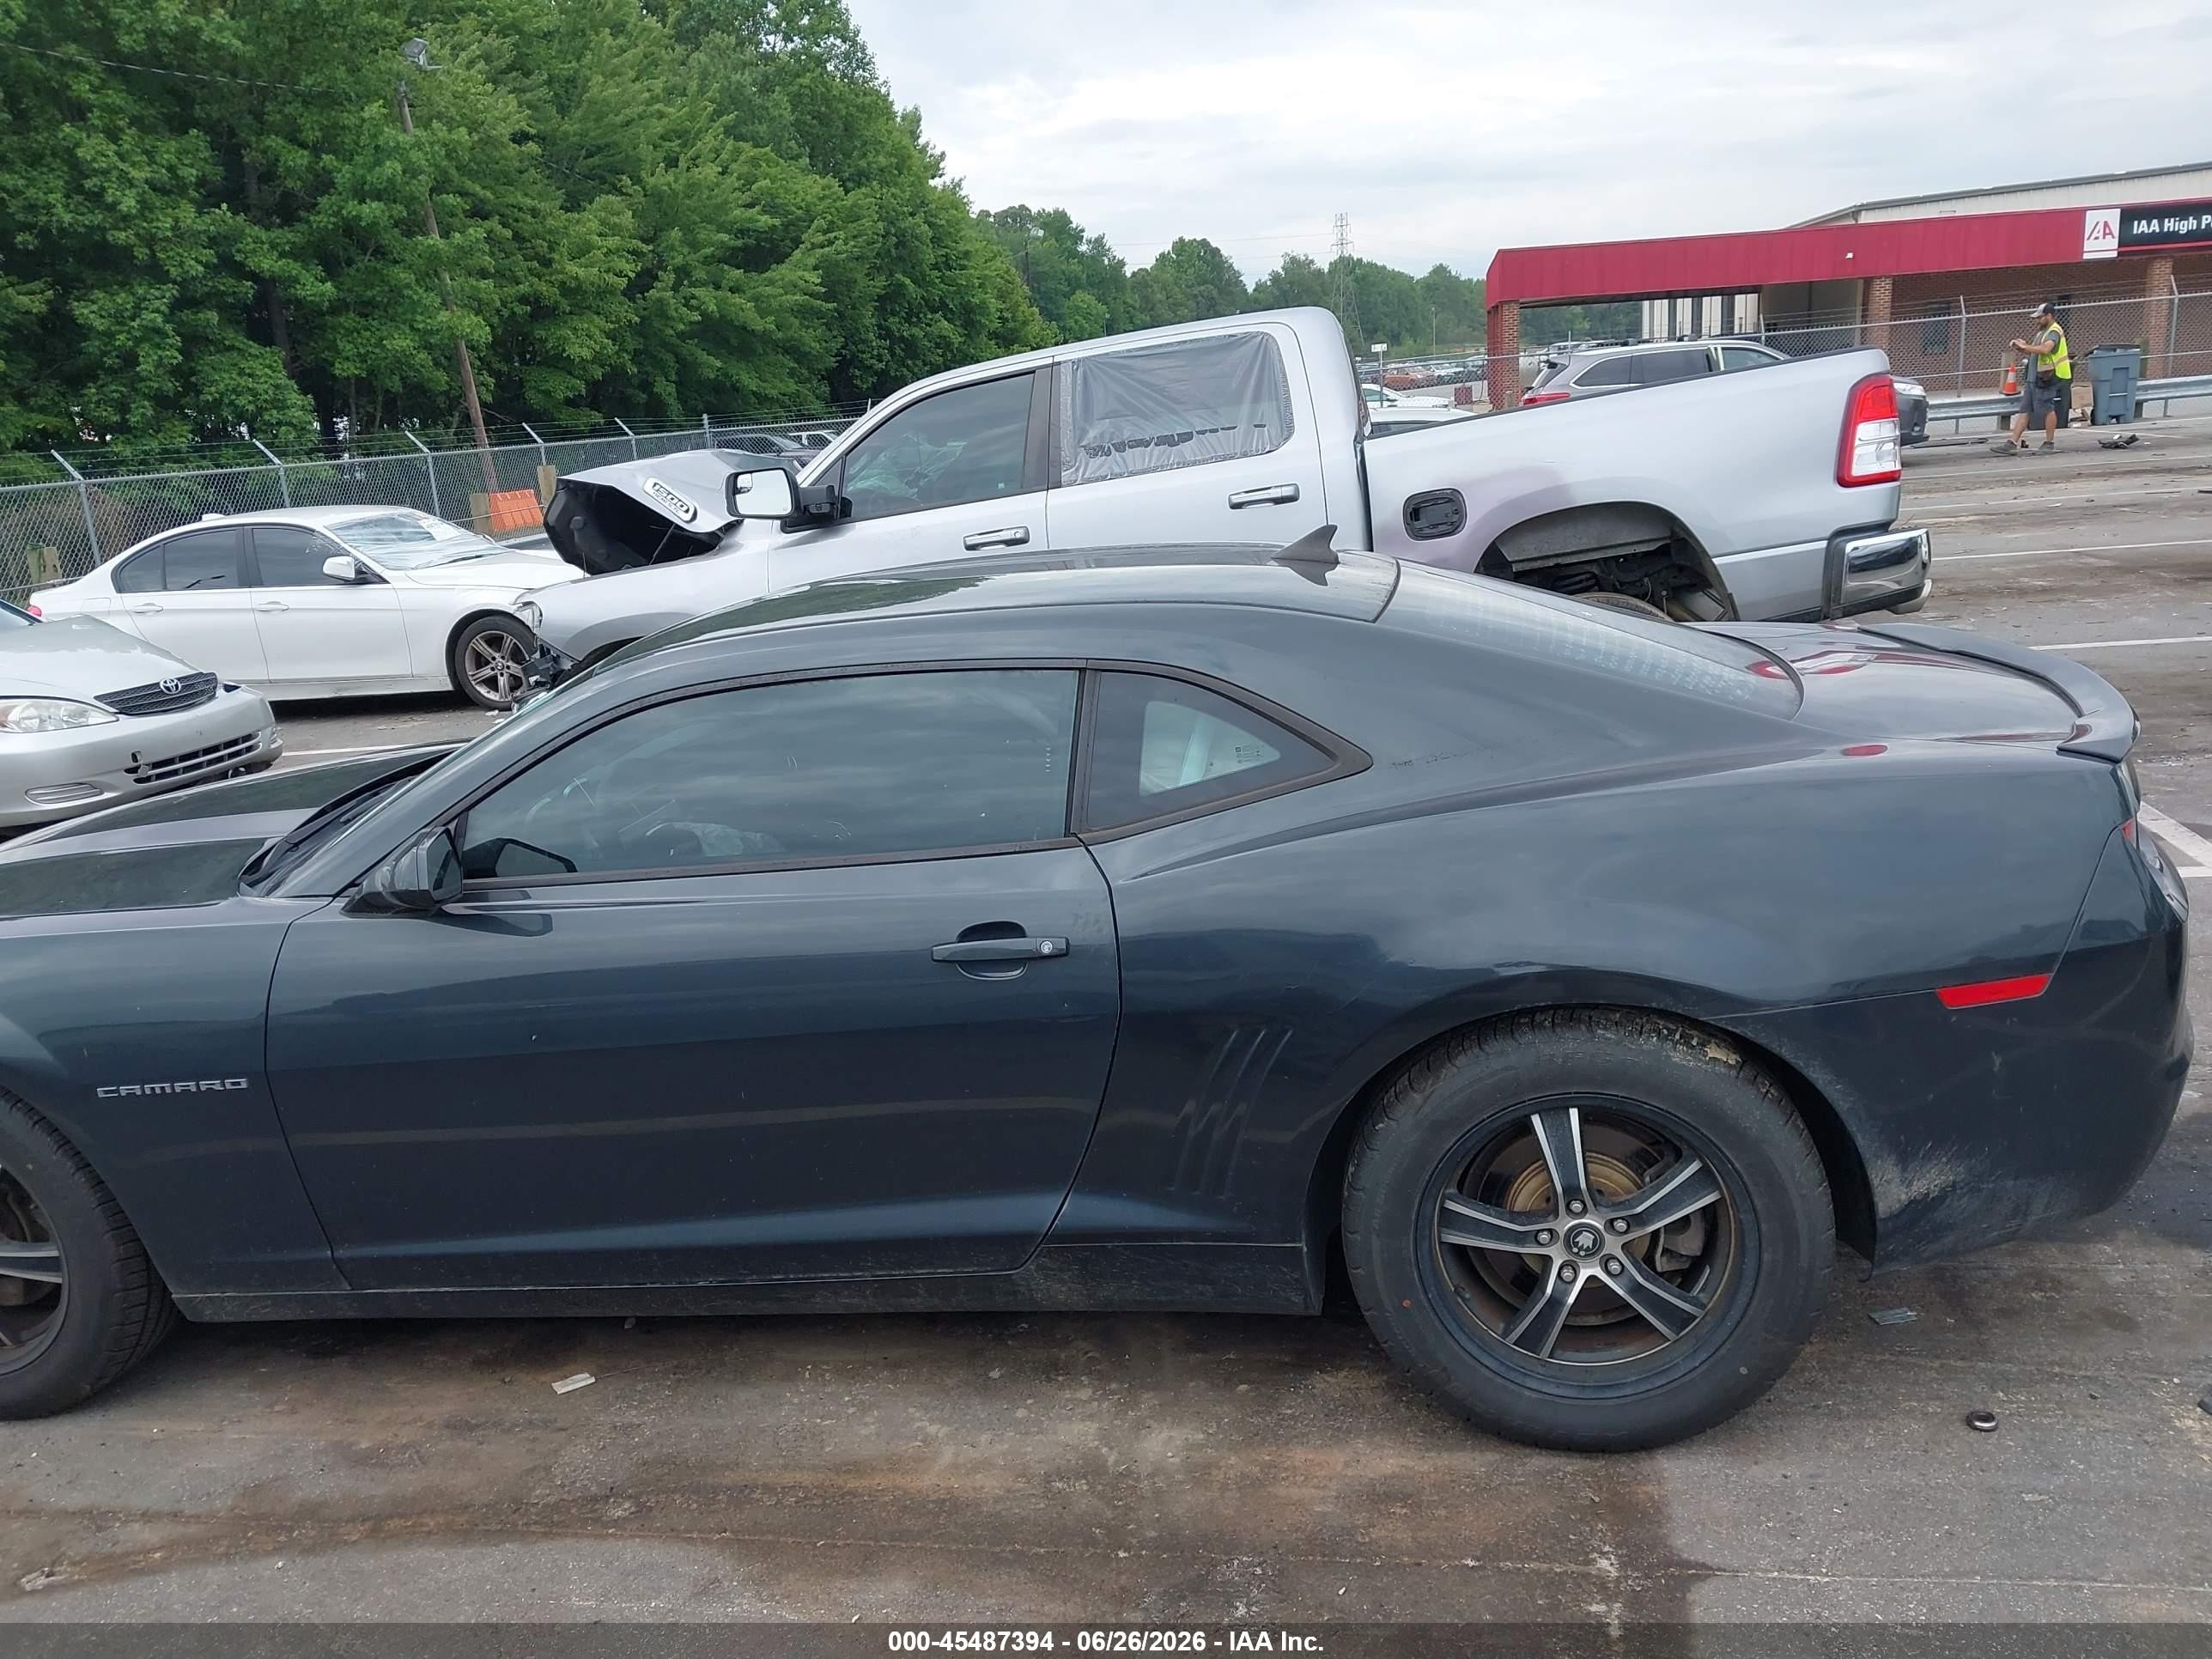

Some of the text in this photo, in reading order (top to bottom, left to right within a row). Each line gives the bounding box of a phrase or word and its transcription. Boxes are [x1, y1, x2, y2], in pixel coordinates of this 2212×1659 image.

[2133, 215, 2212, 234] IAA High P
[653, 482, 690, 514] 1500
[96, 1079, 247, 1097] CAMARO
